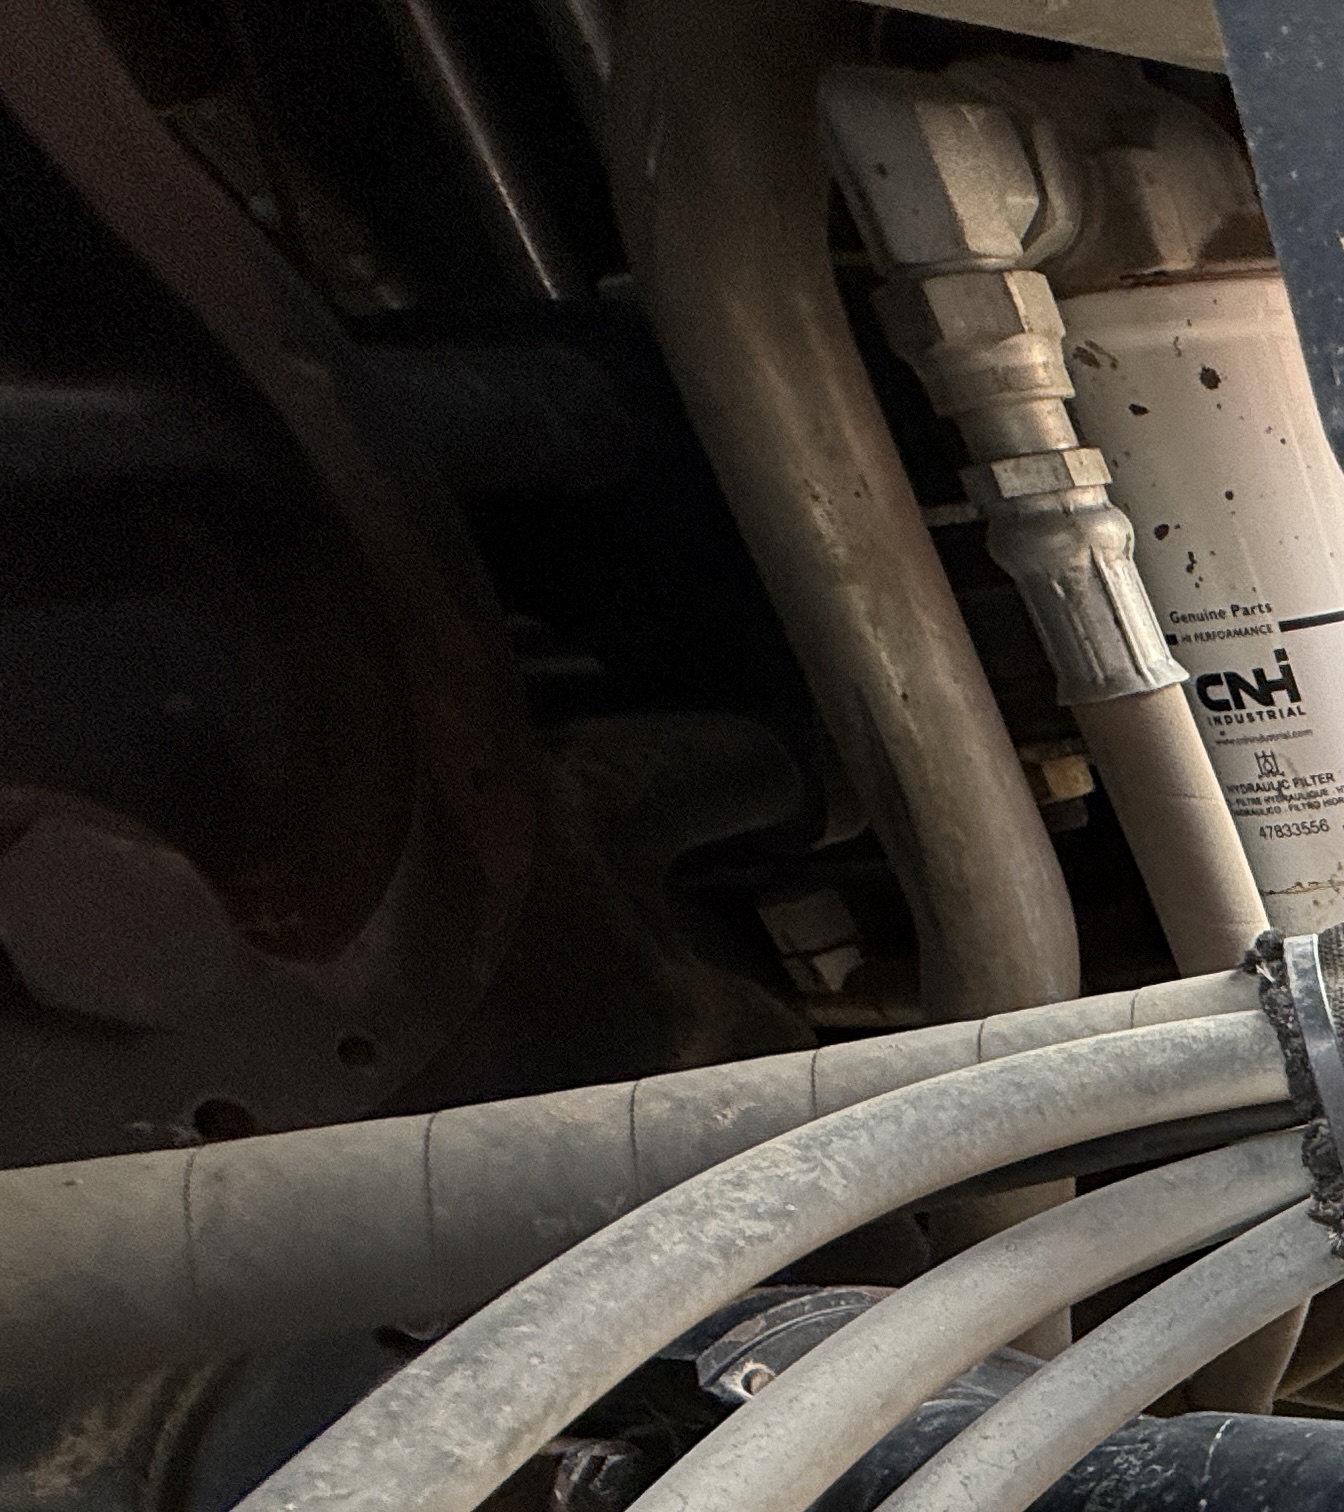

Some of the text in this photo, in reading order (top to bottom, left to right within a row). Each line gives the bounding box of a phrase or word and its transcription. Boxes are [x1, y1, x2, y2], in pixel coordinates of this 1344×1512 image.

[1169, 603, 1273, 624] Genuine Parts
[1194, 623, 1274, 642] PERFORMANCE
[1207, 706, 1307, 726] INDUSTRIAL
[1226, 772, 1336, 795] HYDRAULIC FILTER
[1259, 818, 1330, 839] 47833556
